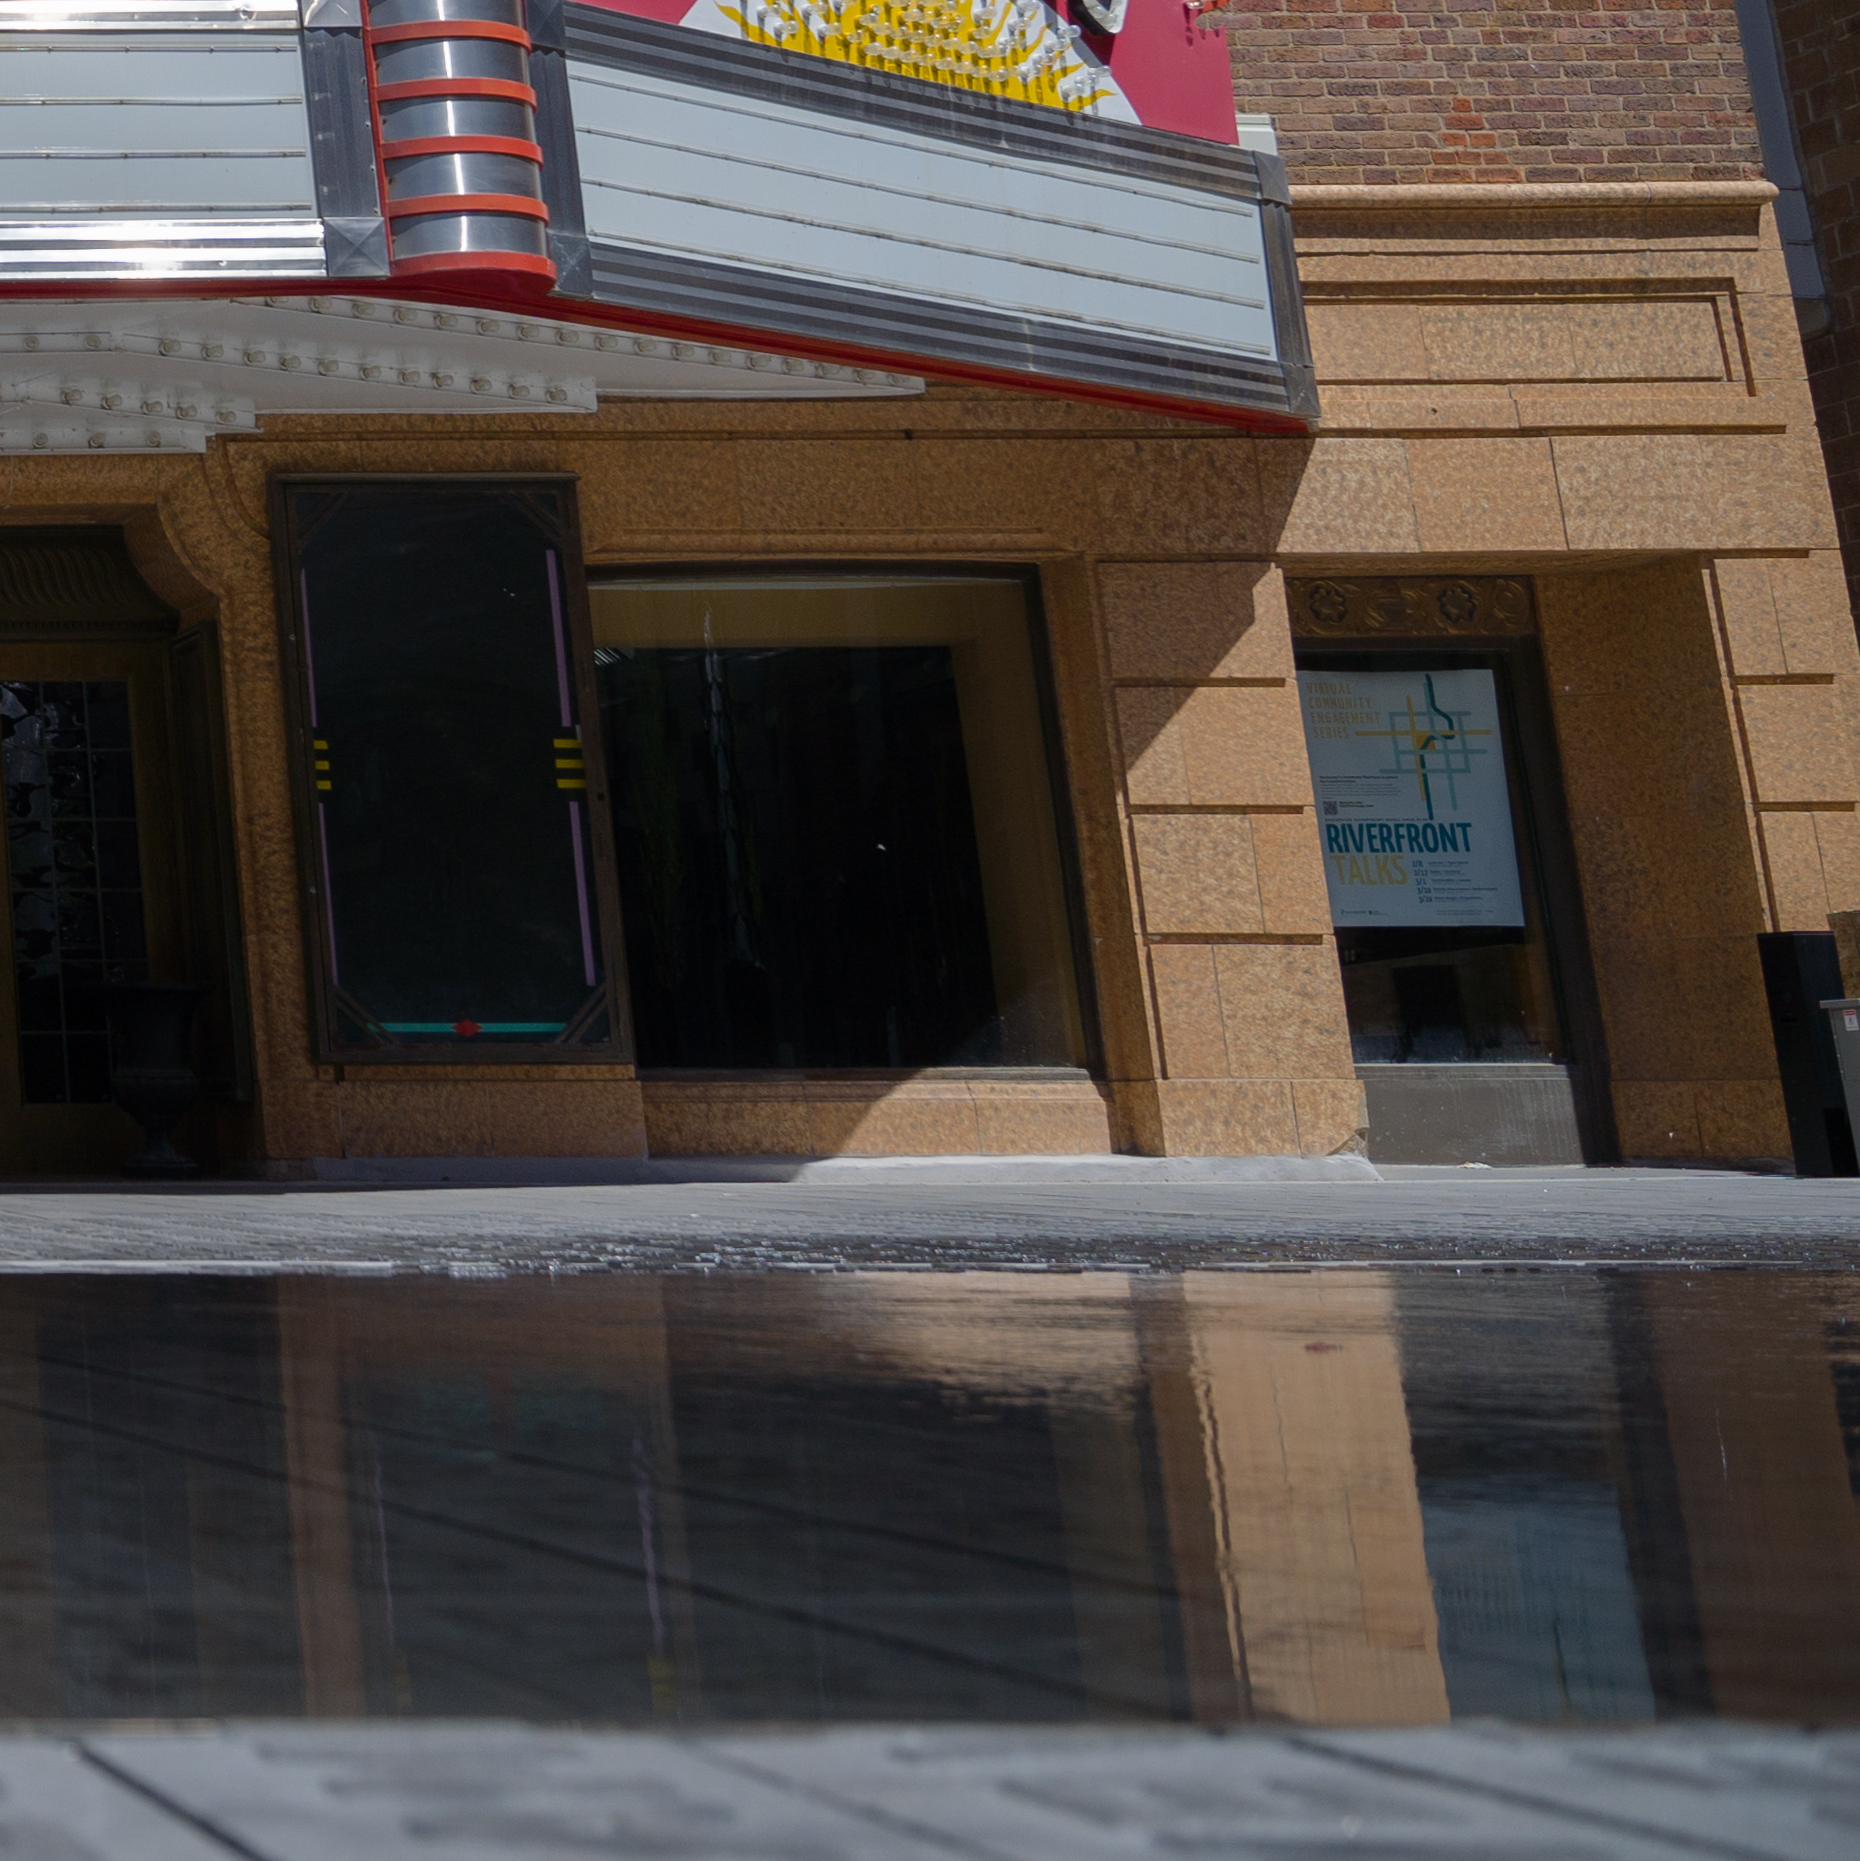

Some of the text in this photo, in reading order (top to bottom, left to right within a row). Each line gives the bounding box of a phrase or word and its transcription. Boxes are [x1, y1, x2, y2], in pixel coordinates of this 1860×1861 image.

[1306, 682, 1352, 695] VIRTUAL
[1308, 697, 1372, 709] COMMUNITY
[1311, 710, 1380, 725] ENGAGEMENT
[1313, 726, 1350, 740] SERIES
[1326, 823, 1472, 853] RIVERFRONT
[1332, 855, 1409, 885] TALKS
